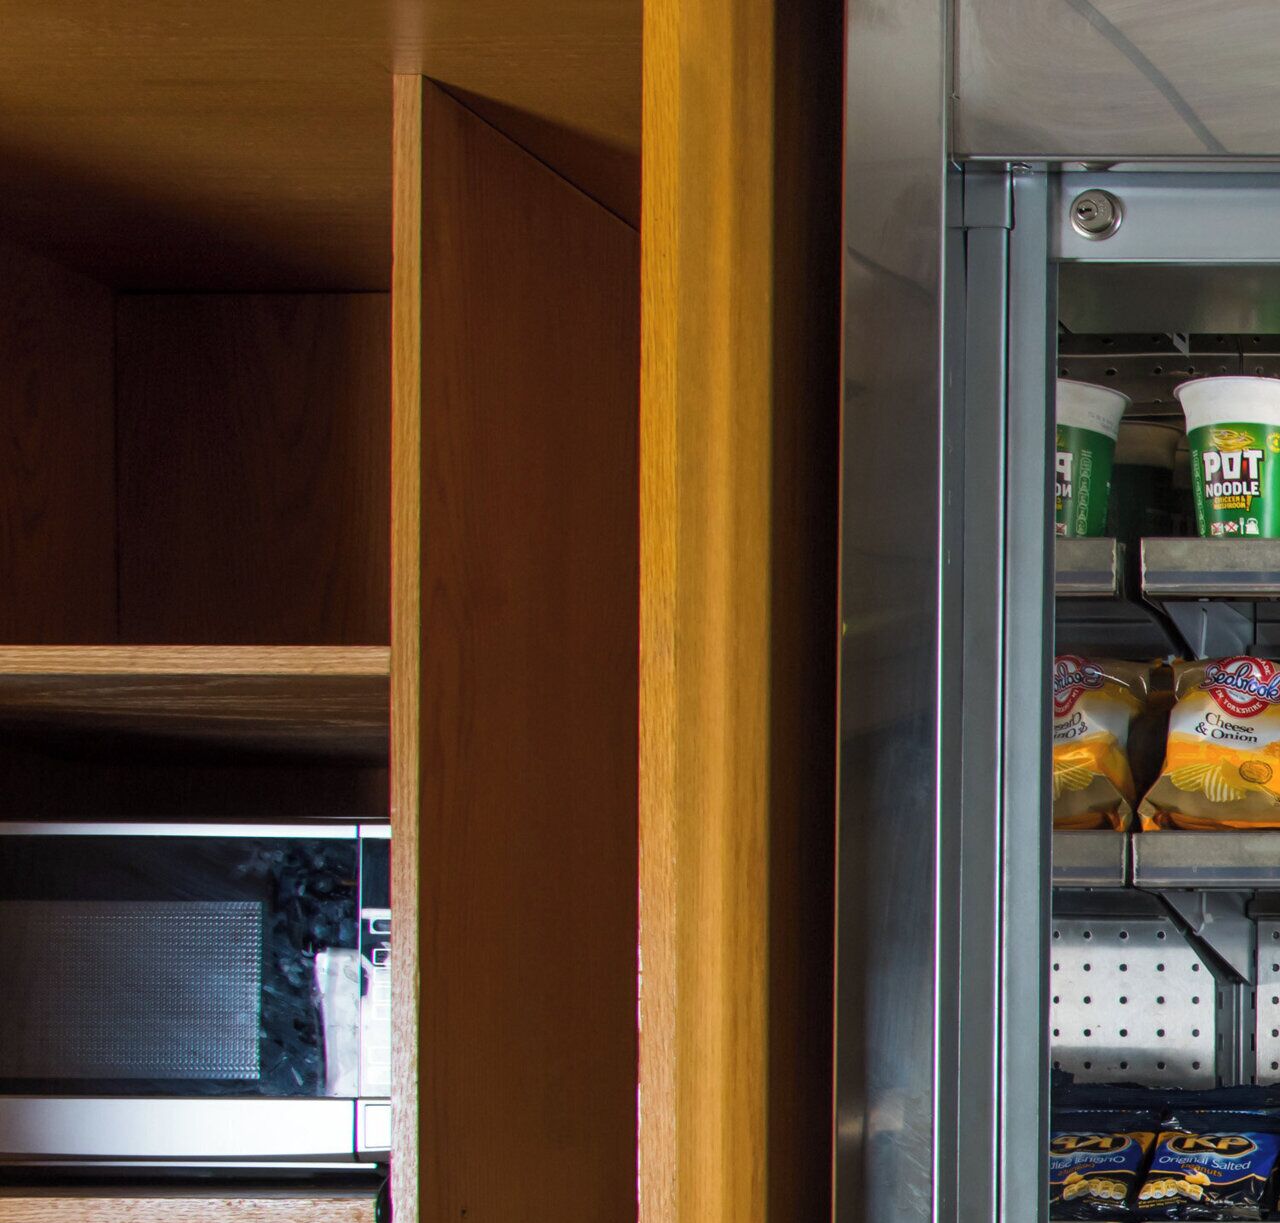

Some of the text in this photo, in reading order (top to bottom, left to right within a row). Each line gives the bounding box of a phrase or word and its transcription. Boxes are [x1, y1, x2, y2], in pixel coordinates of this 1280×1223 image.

[1203, 450, 1264, 482] POT
[1205, 482, 1260, 497] NOODLE
[1223, 696, 1263, 715] YORKSHIRE
[1205, 712, 1255, 734] Cheese
[1195, 722, 1258, 744] & Onion
[1182, 1134, 1249, 1150] KP
[1159, 1155, 1251, 1170] Original Salted
